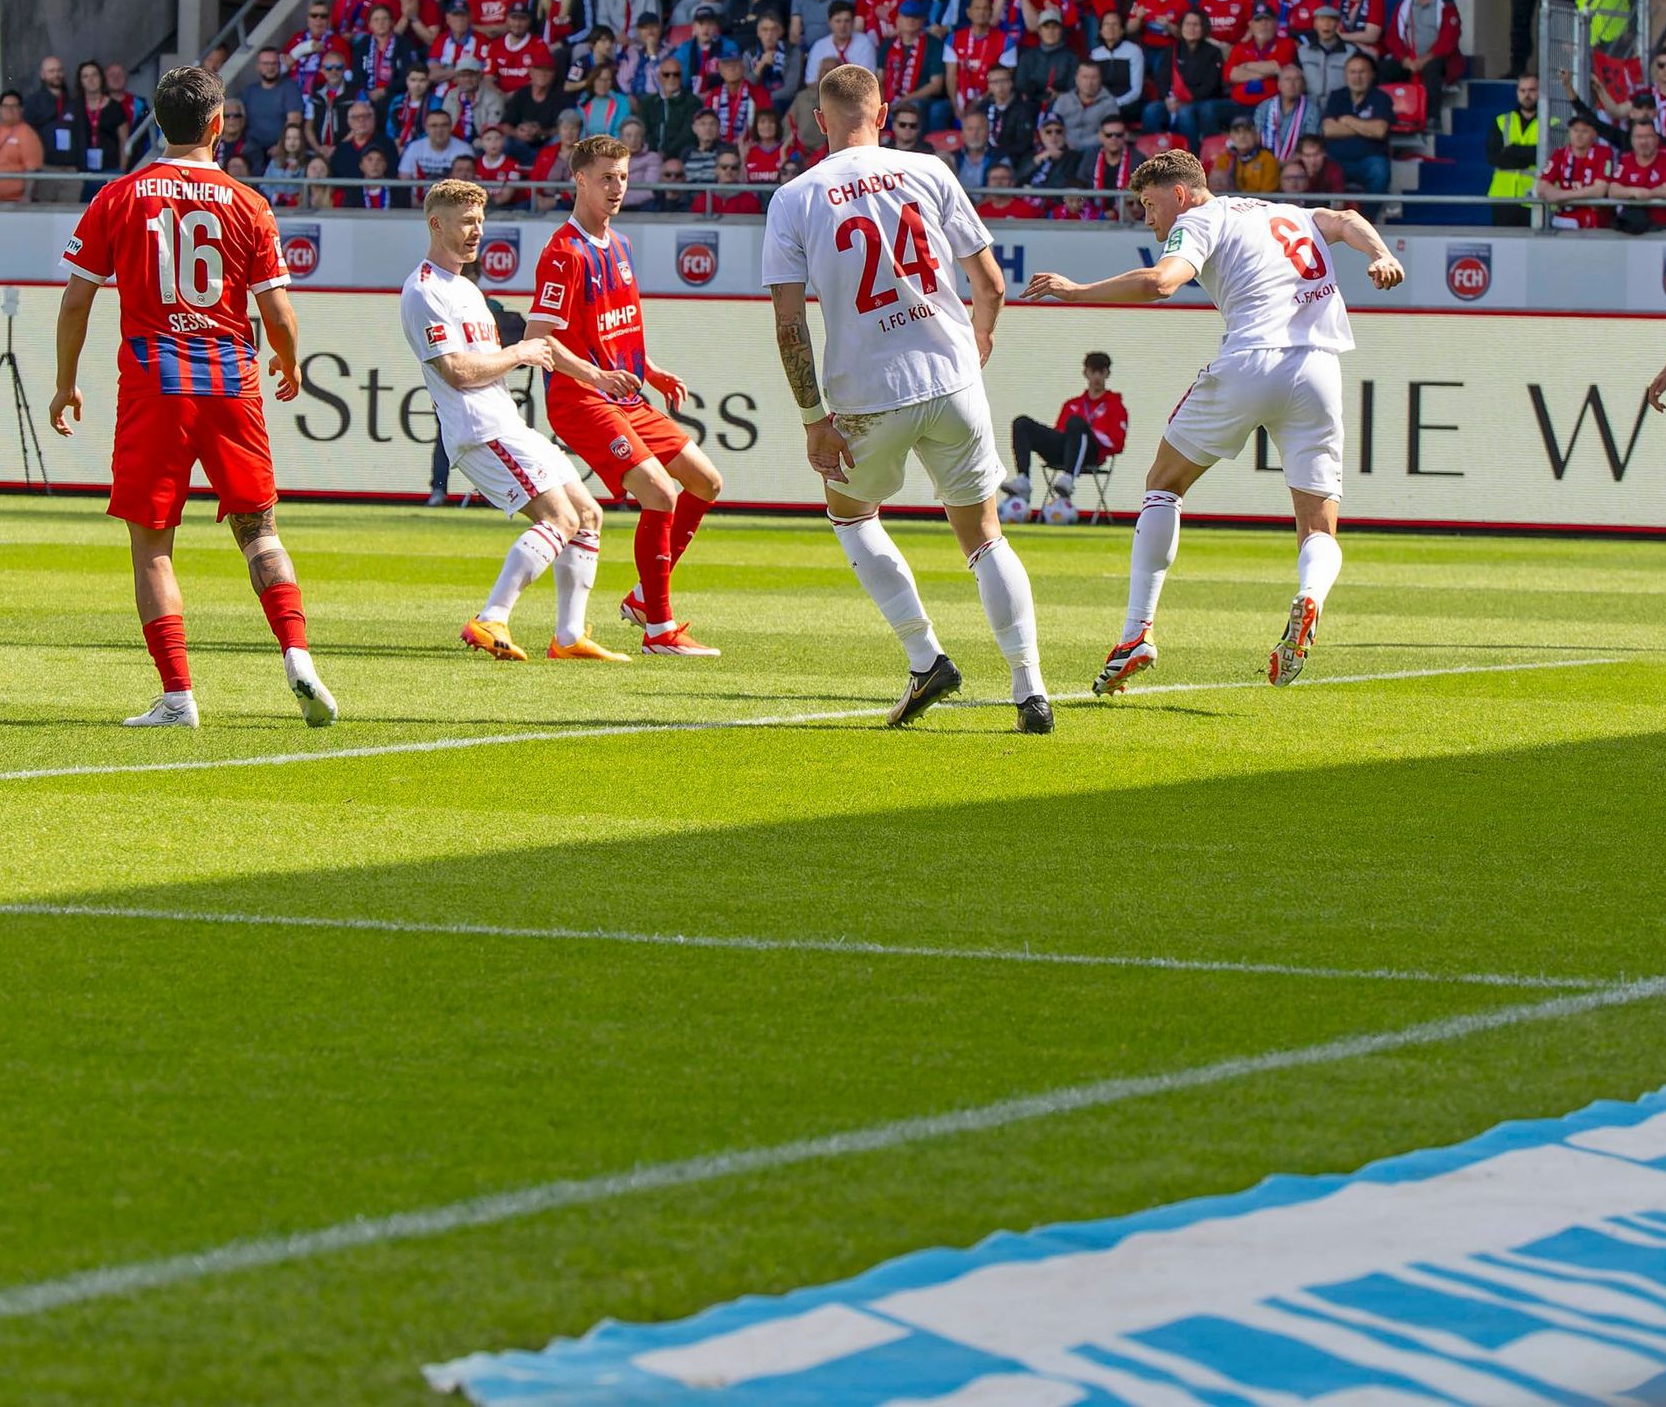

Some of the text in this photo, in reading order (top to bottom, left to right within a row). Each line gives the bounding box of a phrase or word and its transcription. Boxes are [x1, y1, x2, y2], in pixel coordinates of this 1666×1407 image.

[135, 179, 234, 205] HEIDENHEIM
[828, 173, 905, 206] CHABOT
[147, 207, 224, 308] 16
[485, 253, 513, 270] FCH
[835, 202, 939, 314] 24
[1269, 216, 1327, 281] 6
[682, 255, 711, 272] FCH
[1453, 271, 1484, 289] FCH
[168, 312, 220, 332] SESSA
[605, 305, 637, 330] MHP
[1254, 380, 1465, 476] IE
